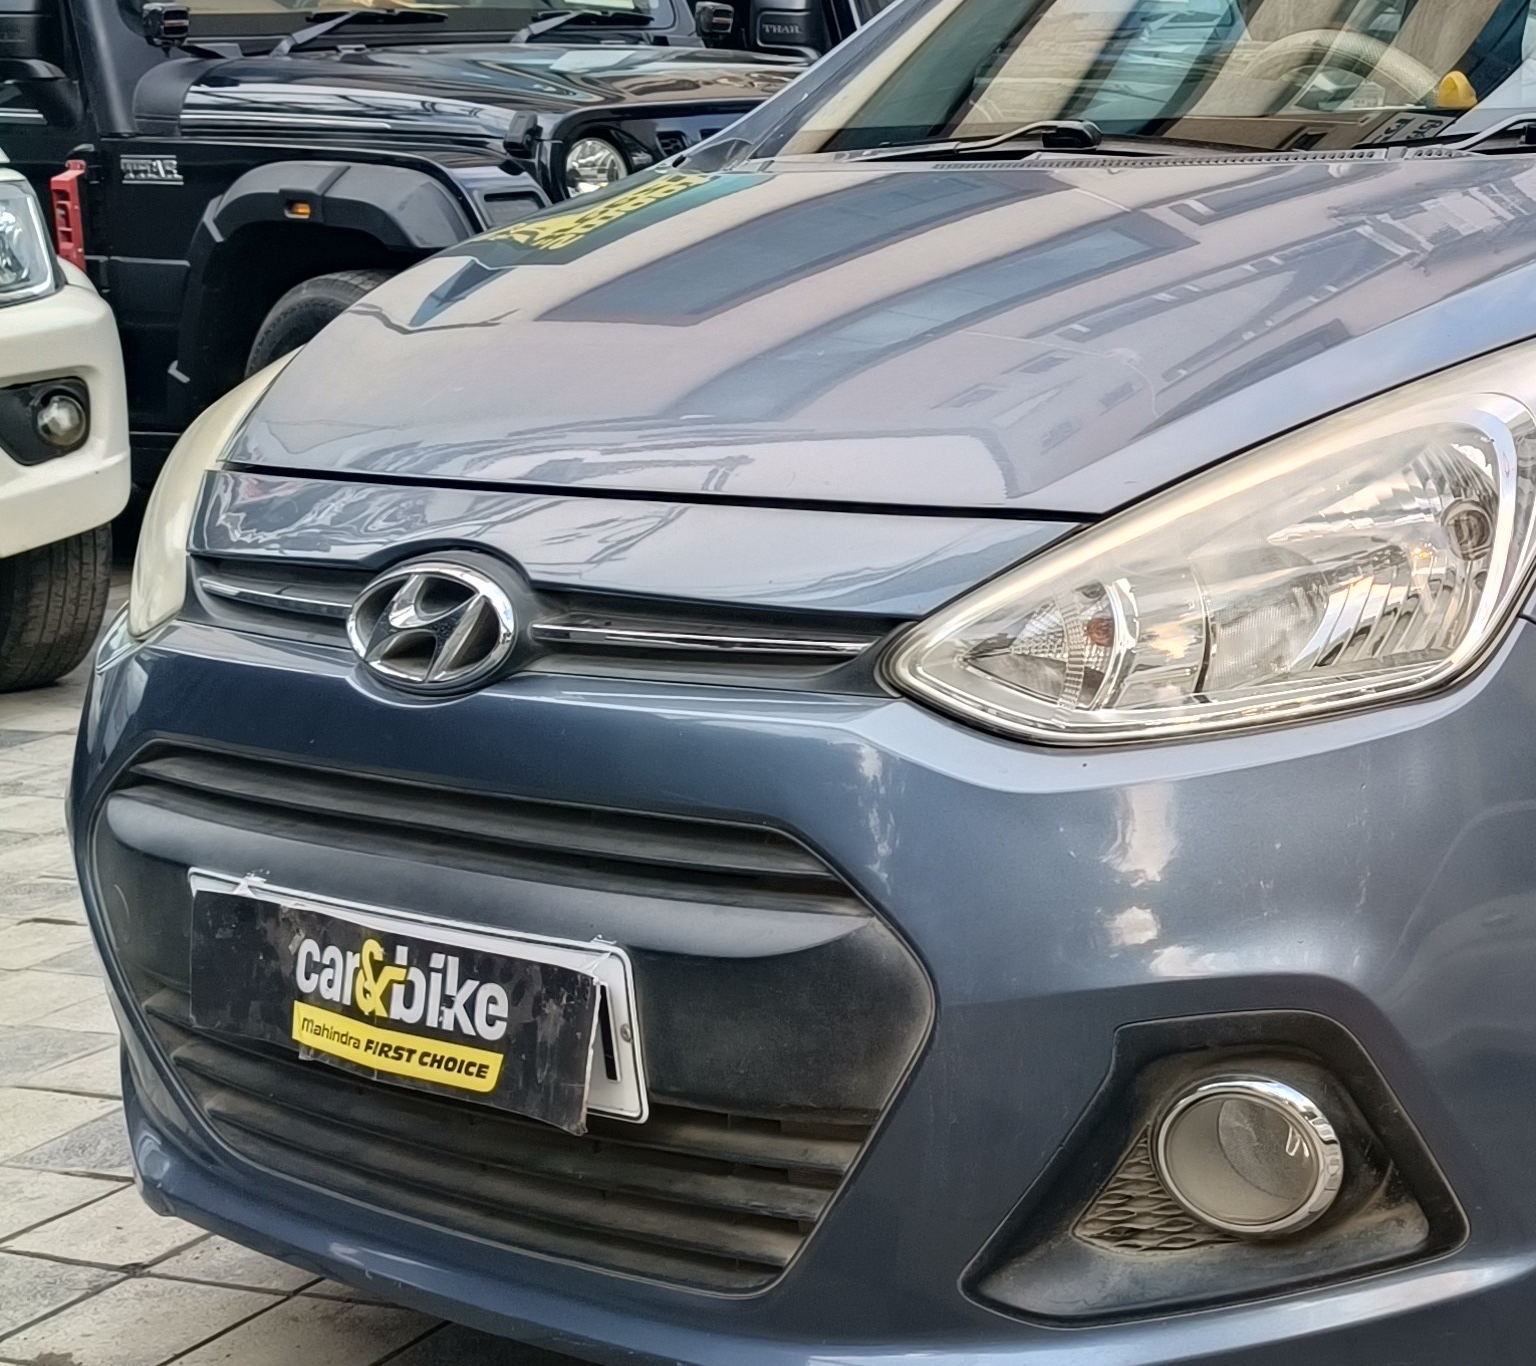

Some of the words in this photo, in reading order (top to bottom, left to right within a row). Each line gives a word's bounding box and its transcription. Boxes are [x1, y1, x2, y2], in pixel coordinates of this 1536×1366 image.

[296, 939, 509, 1041] car&bike
[363, 1038, 417, 1064] FIRST
[418, 1051, 490, 1080] CHOICE
